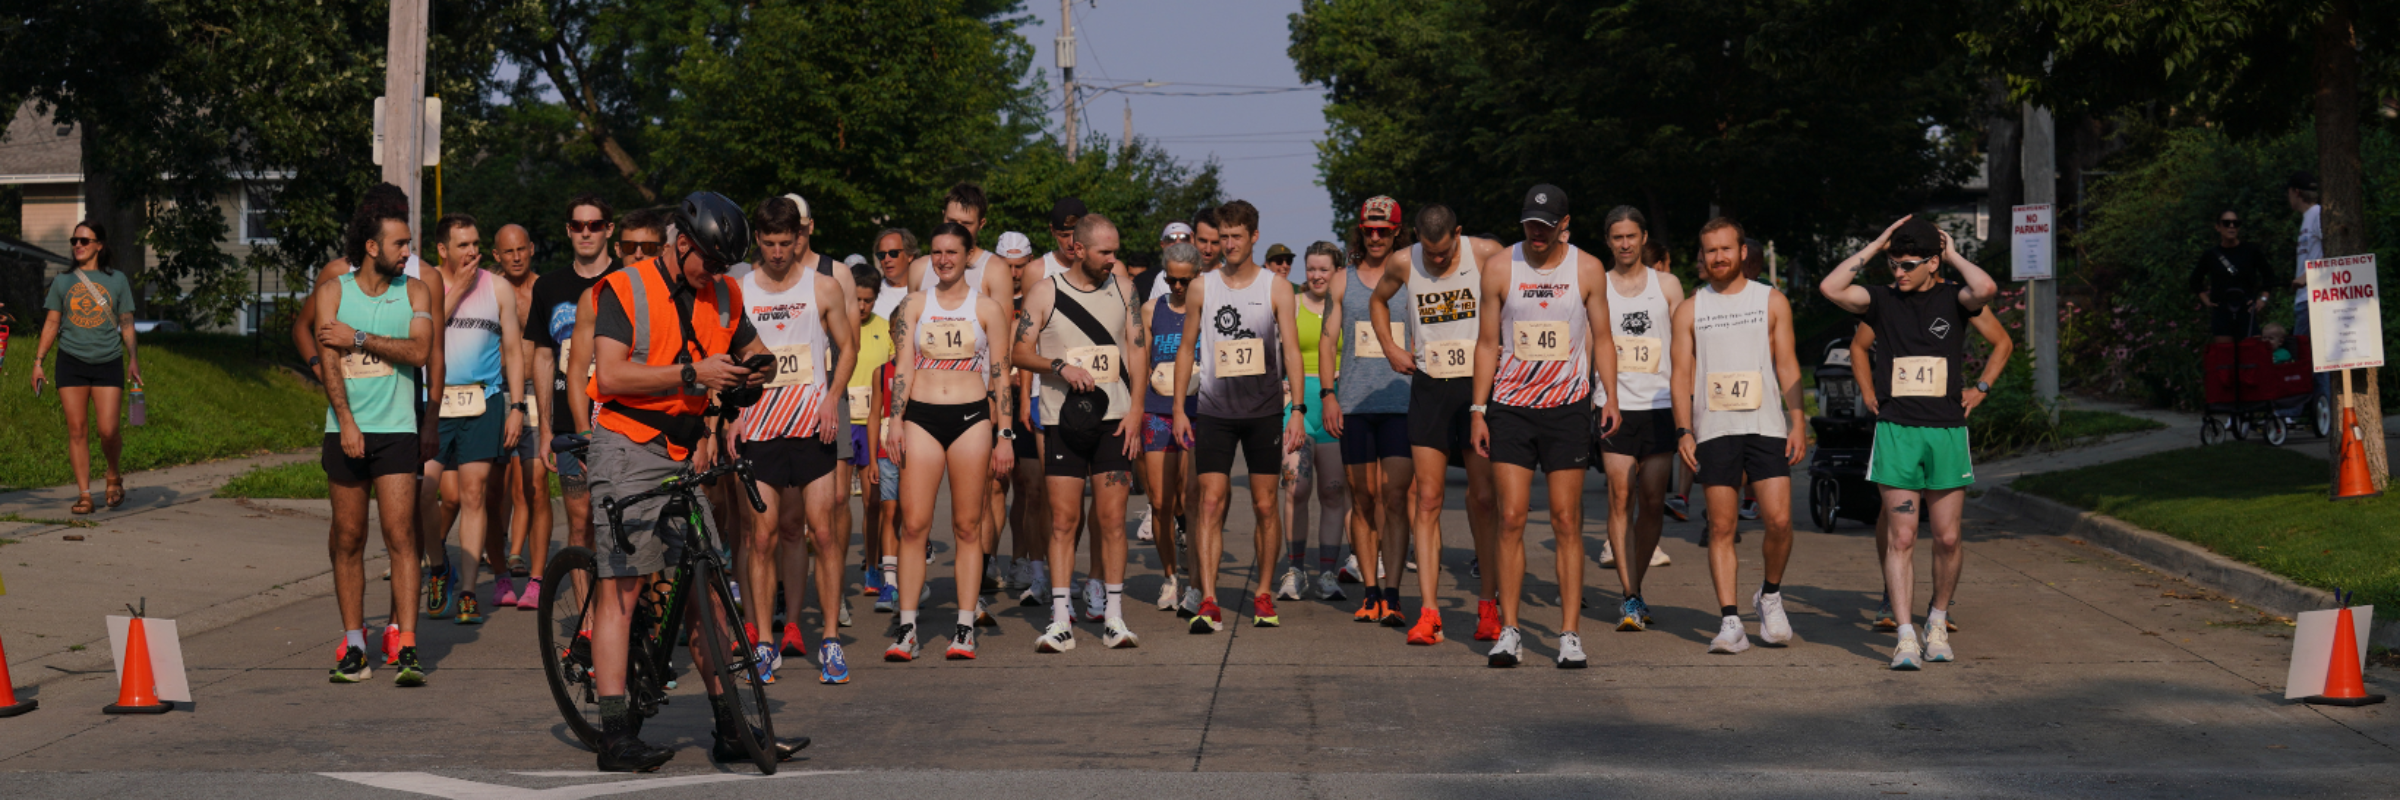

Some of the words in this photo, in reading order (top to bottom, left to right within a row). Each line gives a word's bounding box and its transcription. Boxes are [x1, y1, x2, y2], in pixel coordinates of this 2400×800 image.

[2026, 213, 2037, 223] NO
[2015, 224, 2049, 235] PARKING
[2307, 255, 2373, 269] EMERGENCY
[2331, 270, 2352, 285] NO
[1416, 288, 1475, 306] IOWA
[1522, 289, 1554, 298] IOWA
[2312, 283, 2374, 303] PARKING
[757, 310, 790, 322] IOWA
[945, 330, 962, 348] 14
[1154, 333, 1183, 346] FLEE
[1537, 330, 1557, 349] 46
[1158, 344, 1178, 355] FEE
[1236, 348, 1253, 364] 37
[1447, 348, 1466, 366] 38
[1633, 345, 1649, 362] 13
[779, 354, 798, 374] 20
[1091, 354, 1109, 371] 43
[1915, 366, 1933, 384] 41
[1730, 380, 1749, 397] 47
[457, 391, 473, 406] 57
